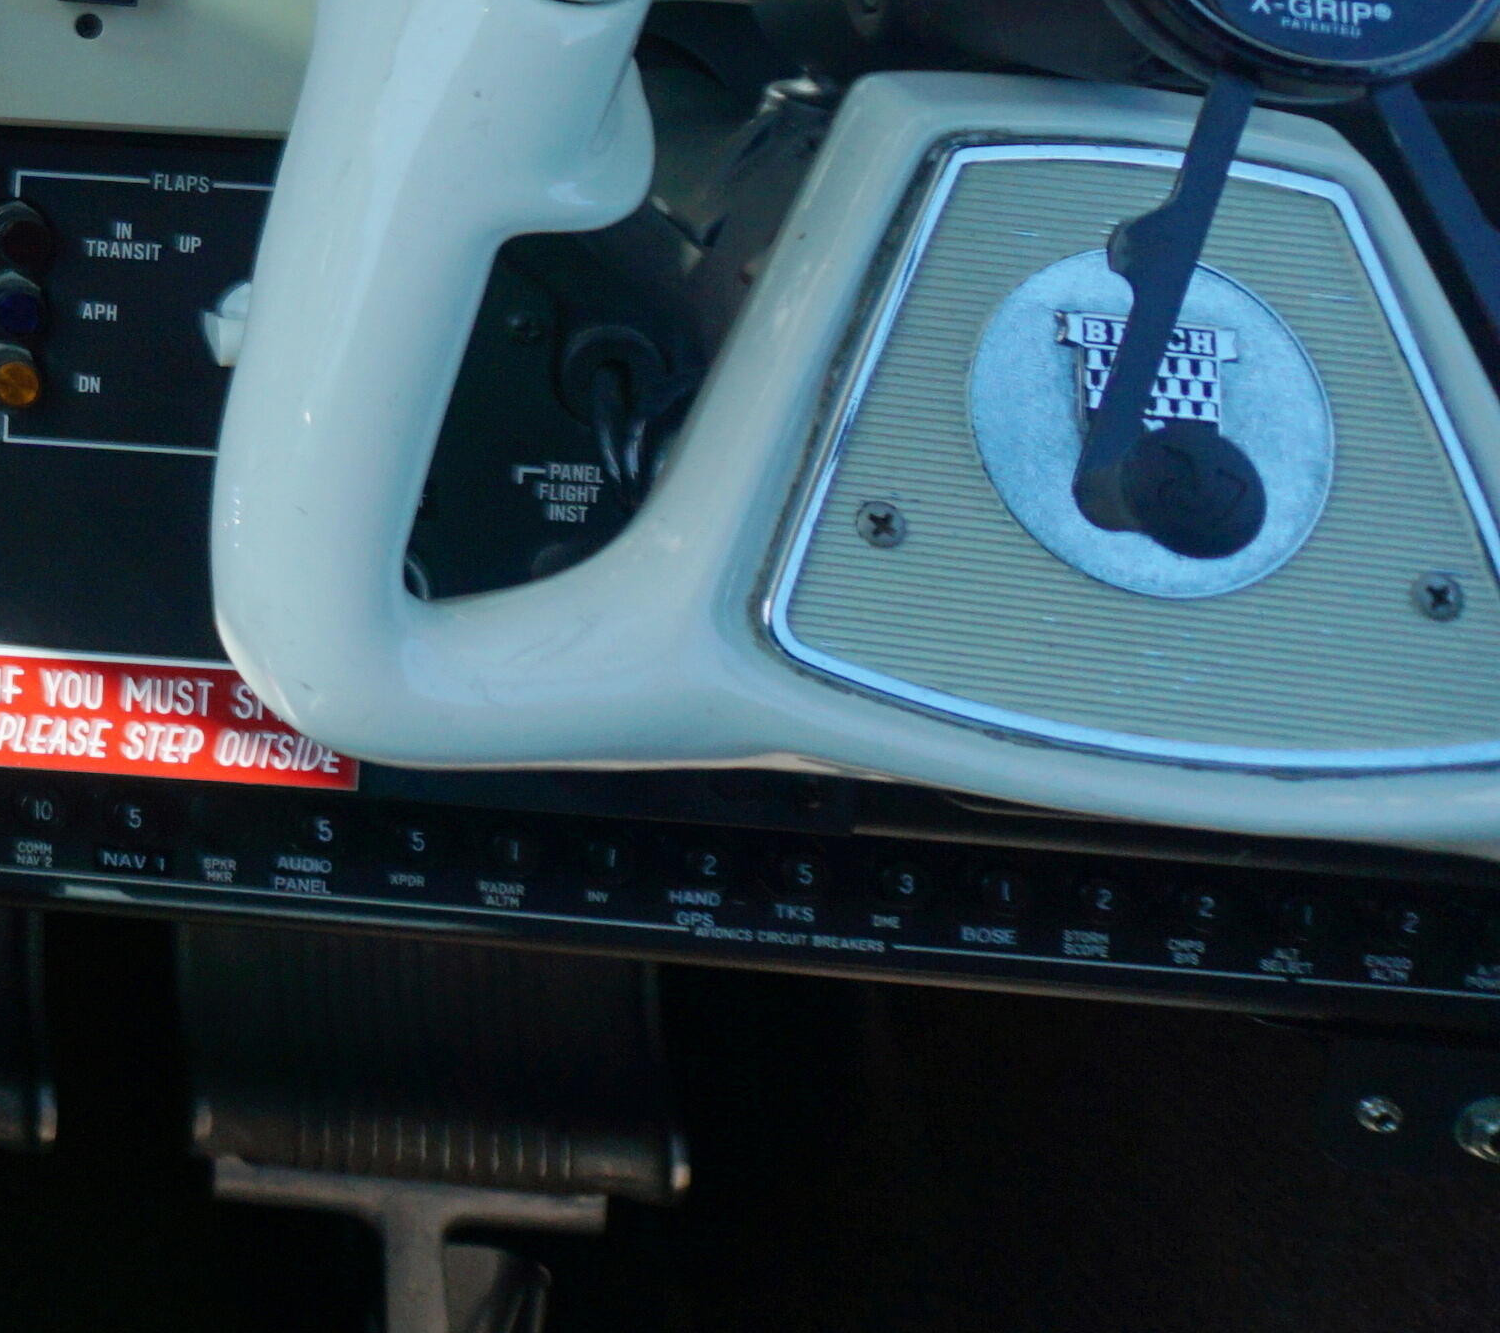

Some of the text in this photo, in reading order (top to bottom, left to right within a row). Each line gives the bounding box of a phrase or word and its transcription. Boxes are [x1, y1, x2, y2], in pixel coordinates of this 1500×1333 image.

[154, 173, 209, 193] FLAPS
[116, 222, 132, 239] IN
[86, 240, 162, 261] TRANSIT
[180, 236, 201, 253] UP
[82, 303, 117, 321] APH
[78, 375, 100, 393] DN
[40, 669, 103, 709] YOU
[120, 677, 214, 716] MUST
[120, 721, 204, 763] STEP
[217, 730, 340, 774] OUTSIDE
